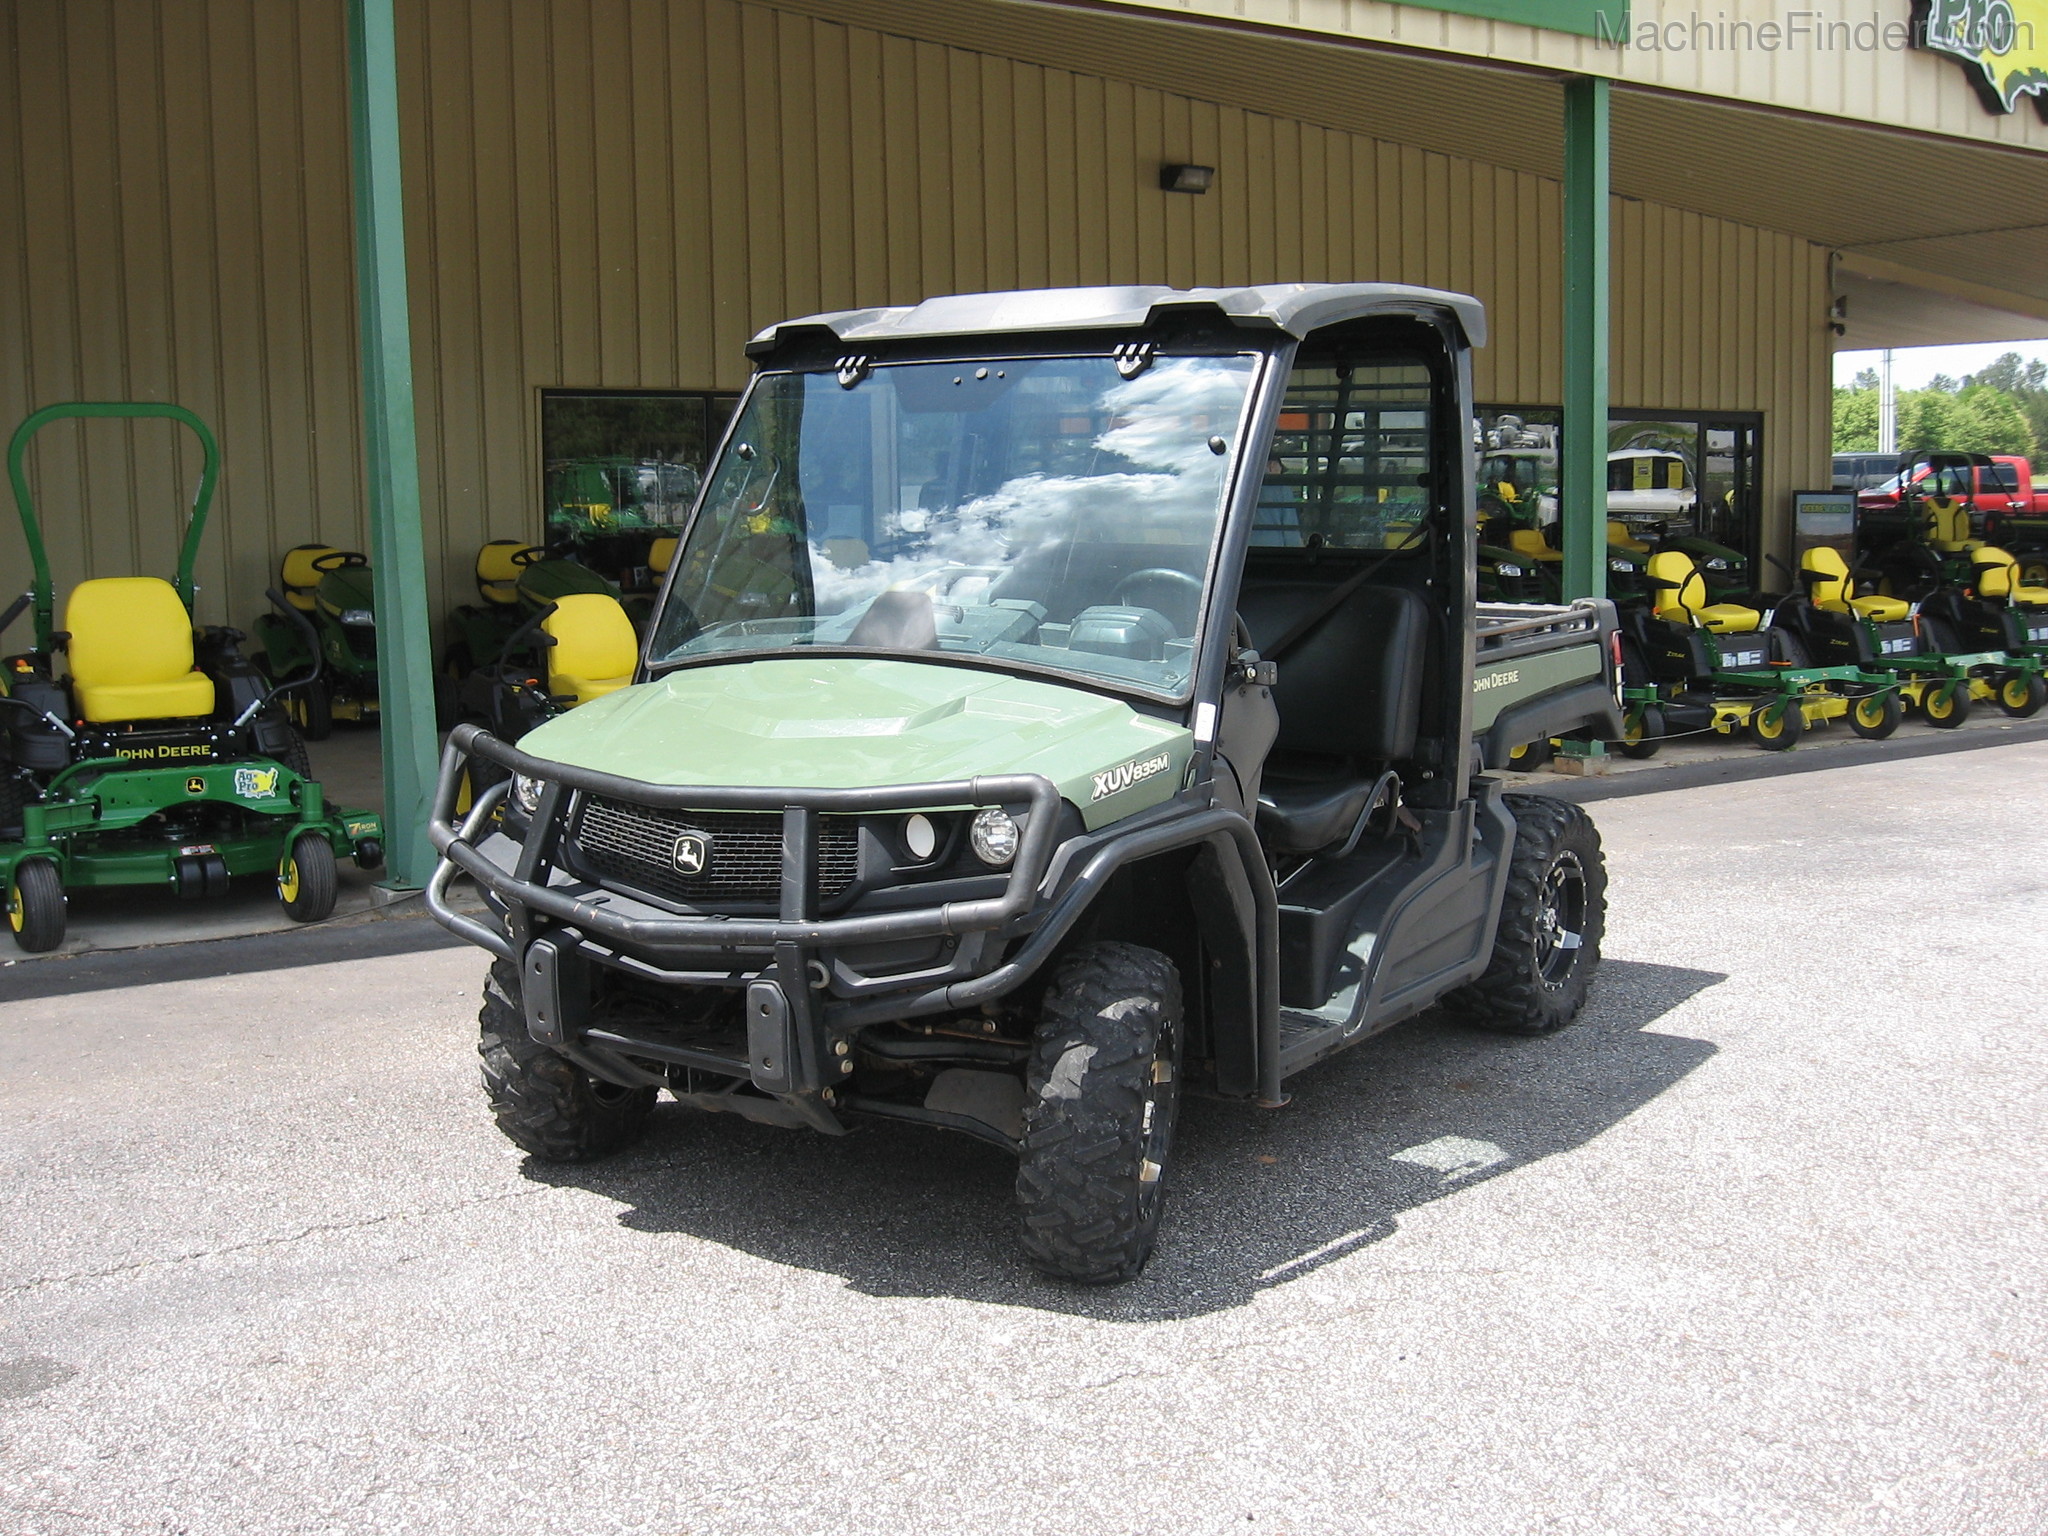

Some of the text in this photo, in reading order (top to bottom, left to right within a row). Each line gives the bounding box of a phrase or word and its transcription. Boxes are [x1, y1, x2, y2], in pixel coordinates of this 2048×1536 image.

[1491, 670, 1519, 688] DEERE
[115, 744, 211, 759] JOHN DEERE
[240, 782, 258, 791] Pro
